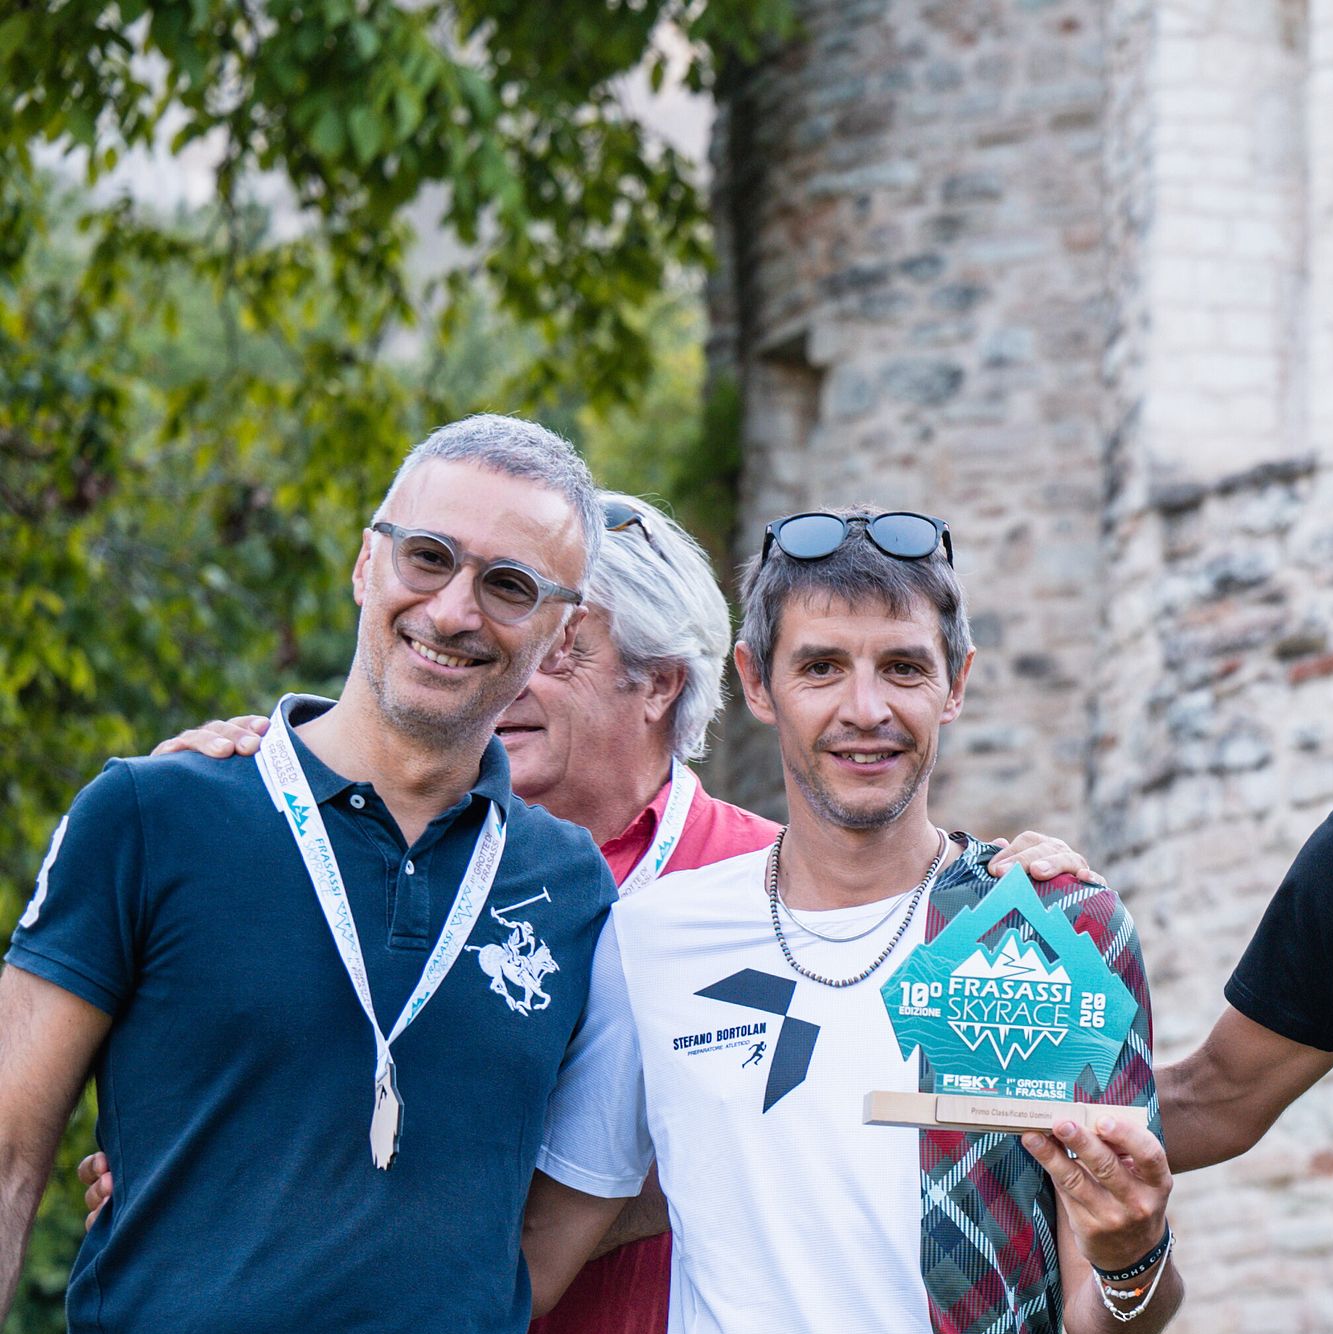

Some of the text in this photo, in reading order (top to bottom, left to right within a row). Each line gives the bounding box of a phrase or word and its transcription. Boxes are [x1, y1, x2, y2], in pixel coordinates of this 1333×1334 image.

[315, 838, 342, 897] FRASASSI
[474, 840, 490, 875] GROTTE
[481, 840, 500, 883] FRASASSI
[948, 978, 1072, 1003] FRASASSI
[1081, 992, 1106, 1009] 20
[899, 1006, 941, 1017] EDIZIONE
[947, 997, 1070, 1028] SKYRACE
[1080, 1010, 1105, 1028] 26
[673, 1022, 767, 1051] STEFANO BORTOLAN
[943, 1074, 999, 1088] FISKY
[1017, 1078, 1066, 1090] GROTTE DI
[1015, 1087, 1066, 1099] FRASASSI
